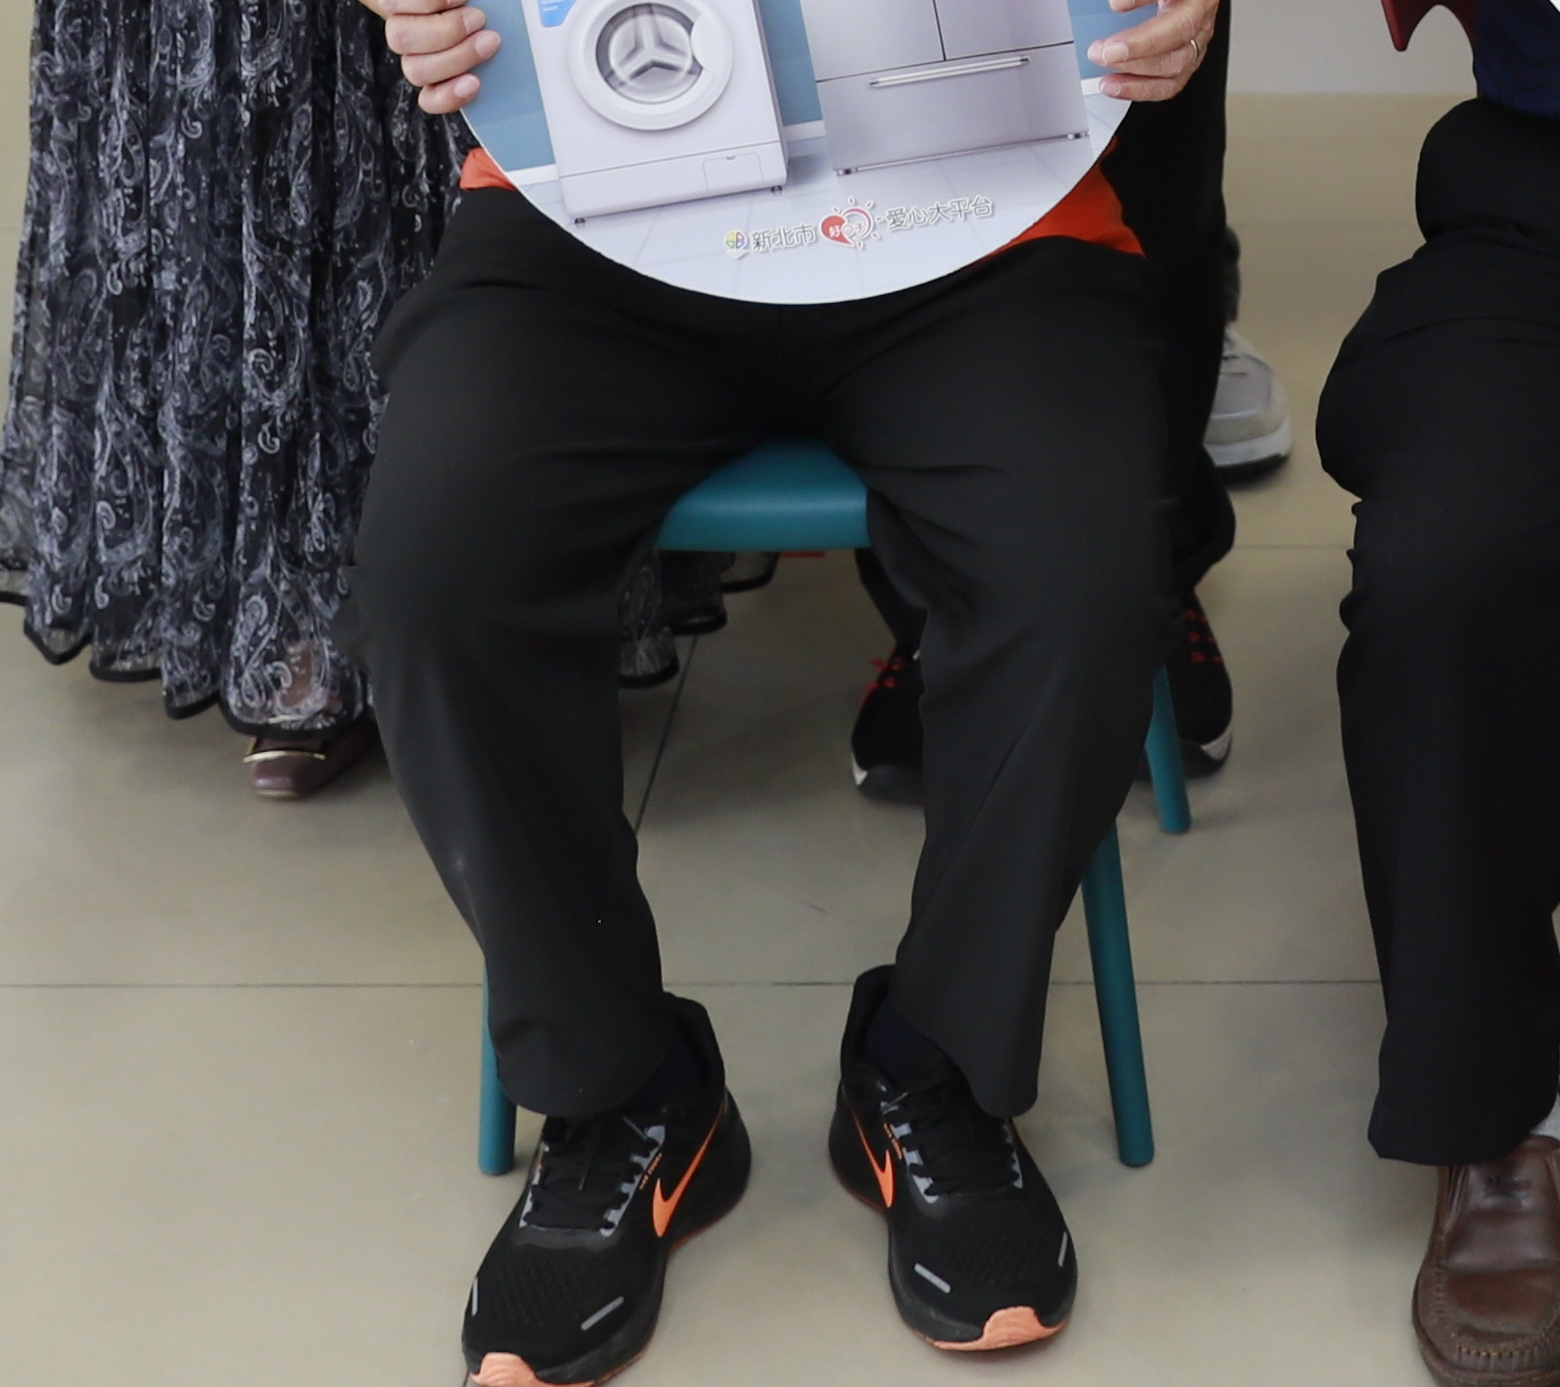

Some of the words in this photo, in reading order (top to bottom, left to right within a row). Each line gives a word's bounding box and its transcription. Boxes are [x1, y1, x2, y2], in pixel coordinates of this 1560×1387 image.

[752, 224, 817, 252] 新北市
[887, 196, 994, 230] 愛心大平台
